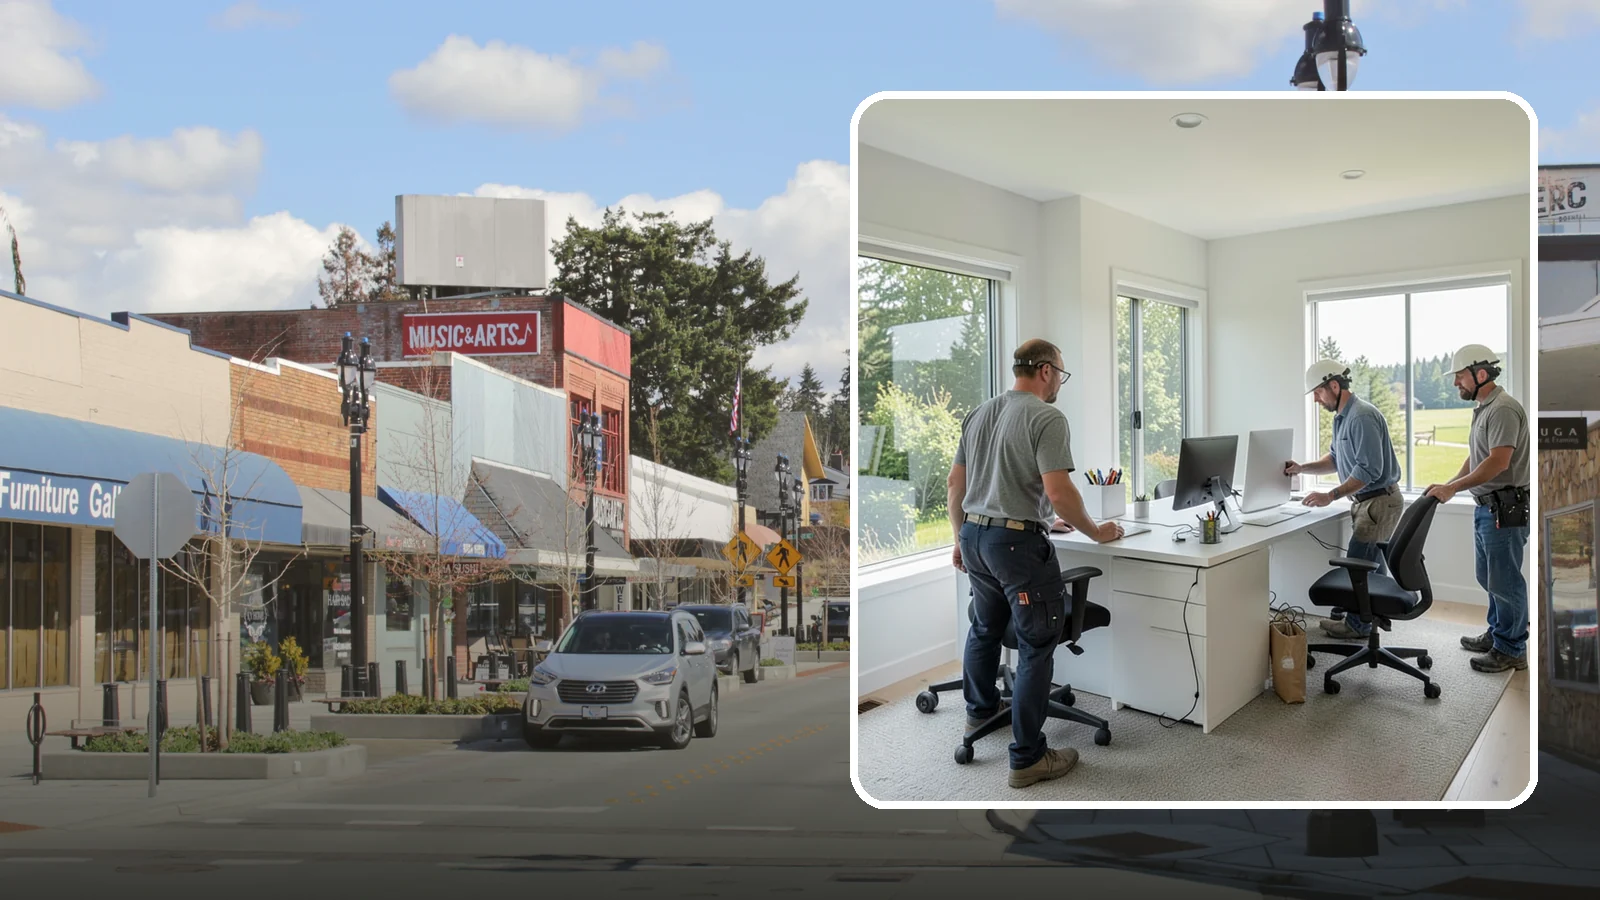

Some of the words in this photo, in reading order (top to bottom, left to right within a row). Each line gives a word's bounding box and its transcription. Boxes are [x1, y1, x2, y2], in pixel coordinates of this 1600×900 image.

[408, 323, 520, 349] MUSIC&ARTS
[1540, 427, 1578, 437] UGA
[0, 471, 79, 515] Furniture
[453, 563, 479, 574] SUSHI
